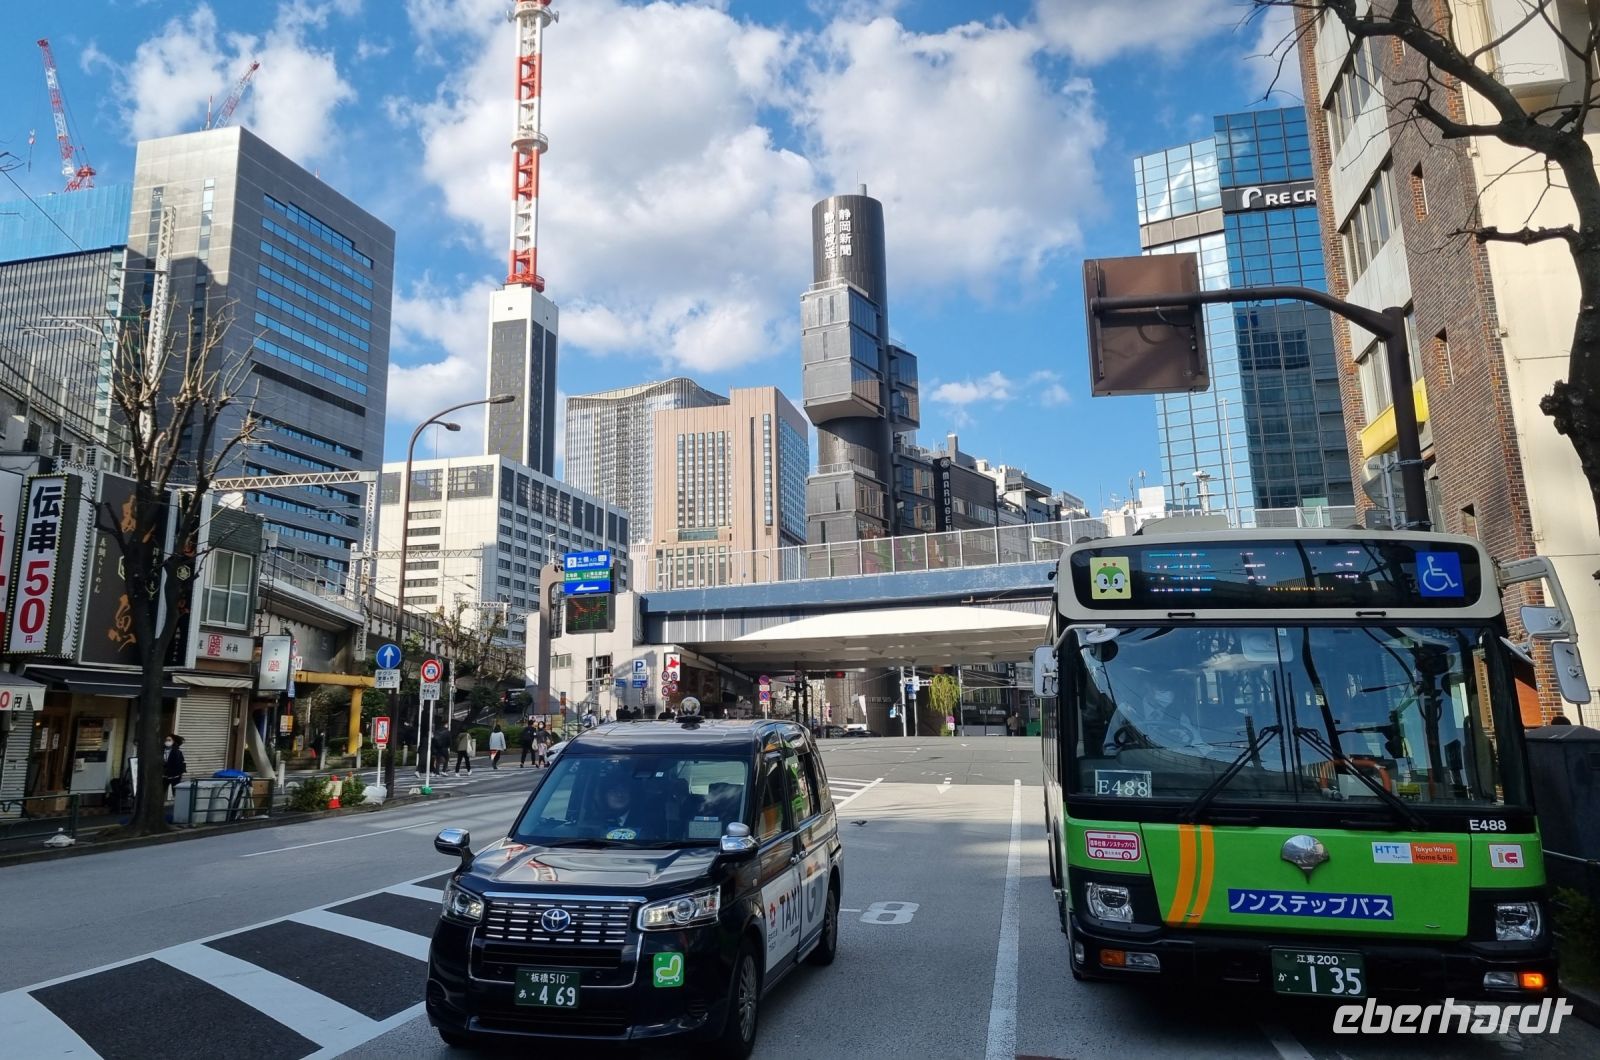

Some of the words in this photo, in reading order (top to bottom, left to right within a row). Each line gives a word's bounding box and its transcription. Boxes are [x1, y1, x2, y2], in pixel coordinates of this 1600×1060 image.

[839, 208, 852, 257] 静岡新聞
[27, 486, 63, 554] 伝串
[1097, 779, 1148, 797] E488
[1469, 819, 1507, 831] E488
[1414, 846, 1433, 854] Tokyo
[779, 886, 800, 932] TAXI
[1231, 892, 1392, 917] ノンステップバス
